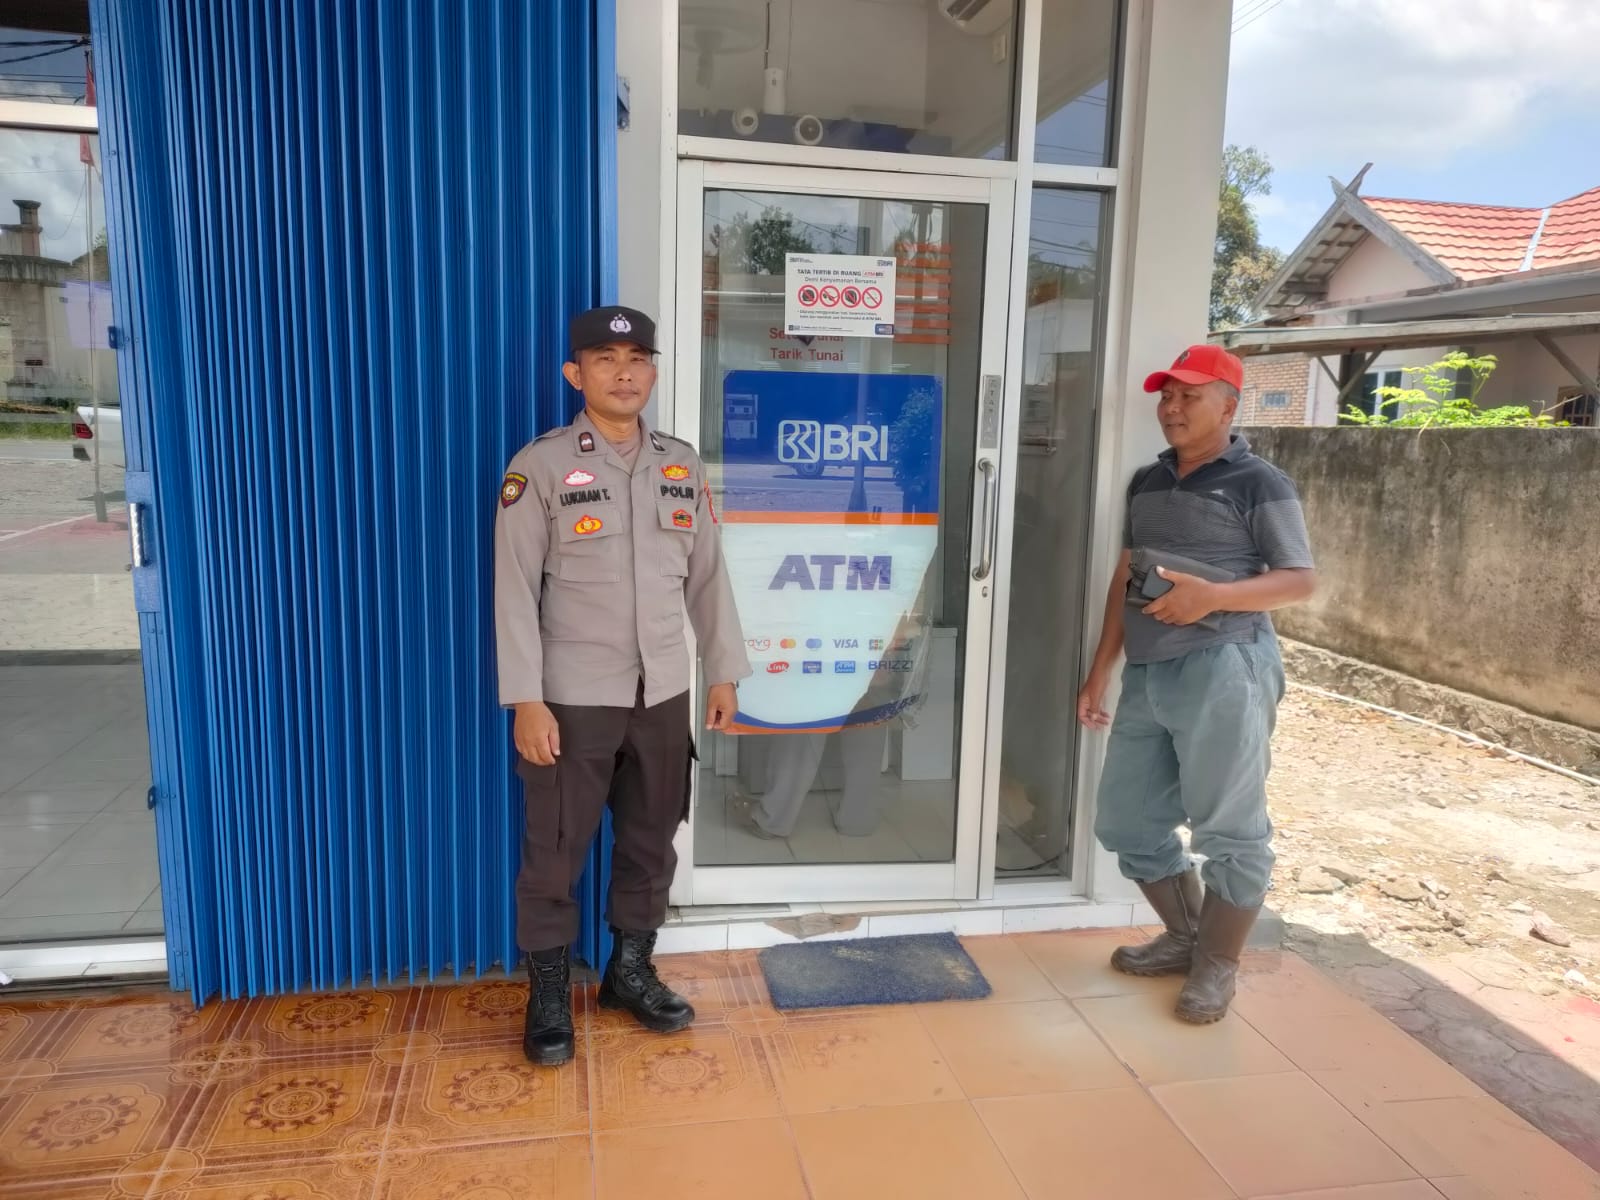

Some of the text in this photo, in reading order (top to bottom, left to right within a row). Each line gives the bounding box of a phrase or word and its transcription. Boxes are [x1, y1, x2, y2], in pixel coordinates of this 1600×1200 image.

[770, 347, 843, 361] Tarik Tunai
[823, 424, 888, 462] BRI
[559, 488, 602, 507] LUKMAN
[660, 484, 694, 500] POLRI
[768, 554, 892, 591] ATM
[833, 639, 859, 648] VISA
[766, 661, 789, 672] Link
